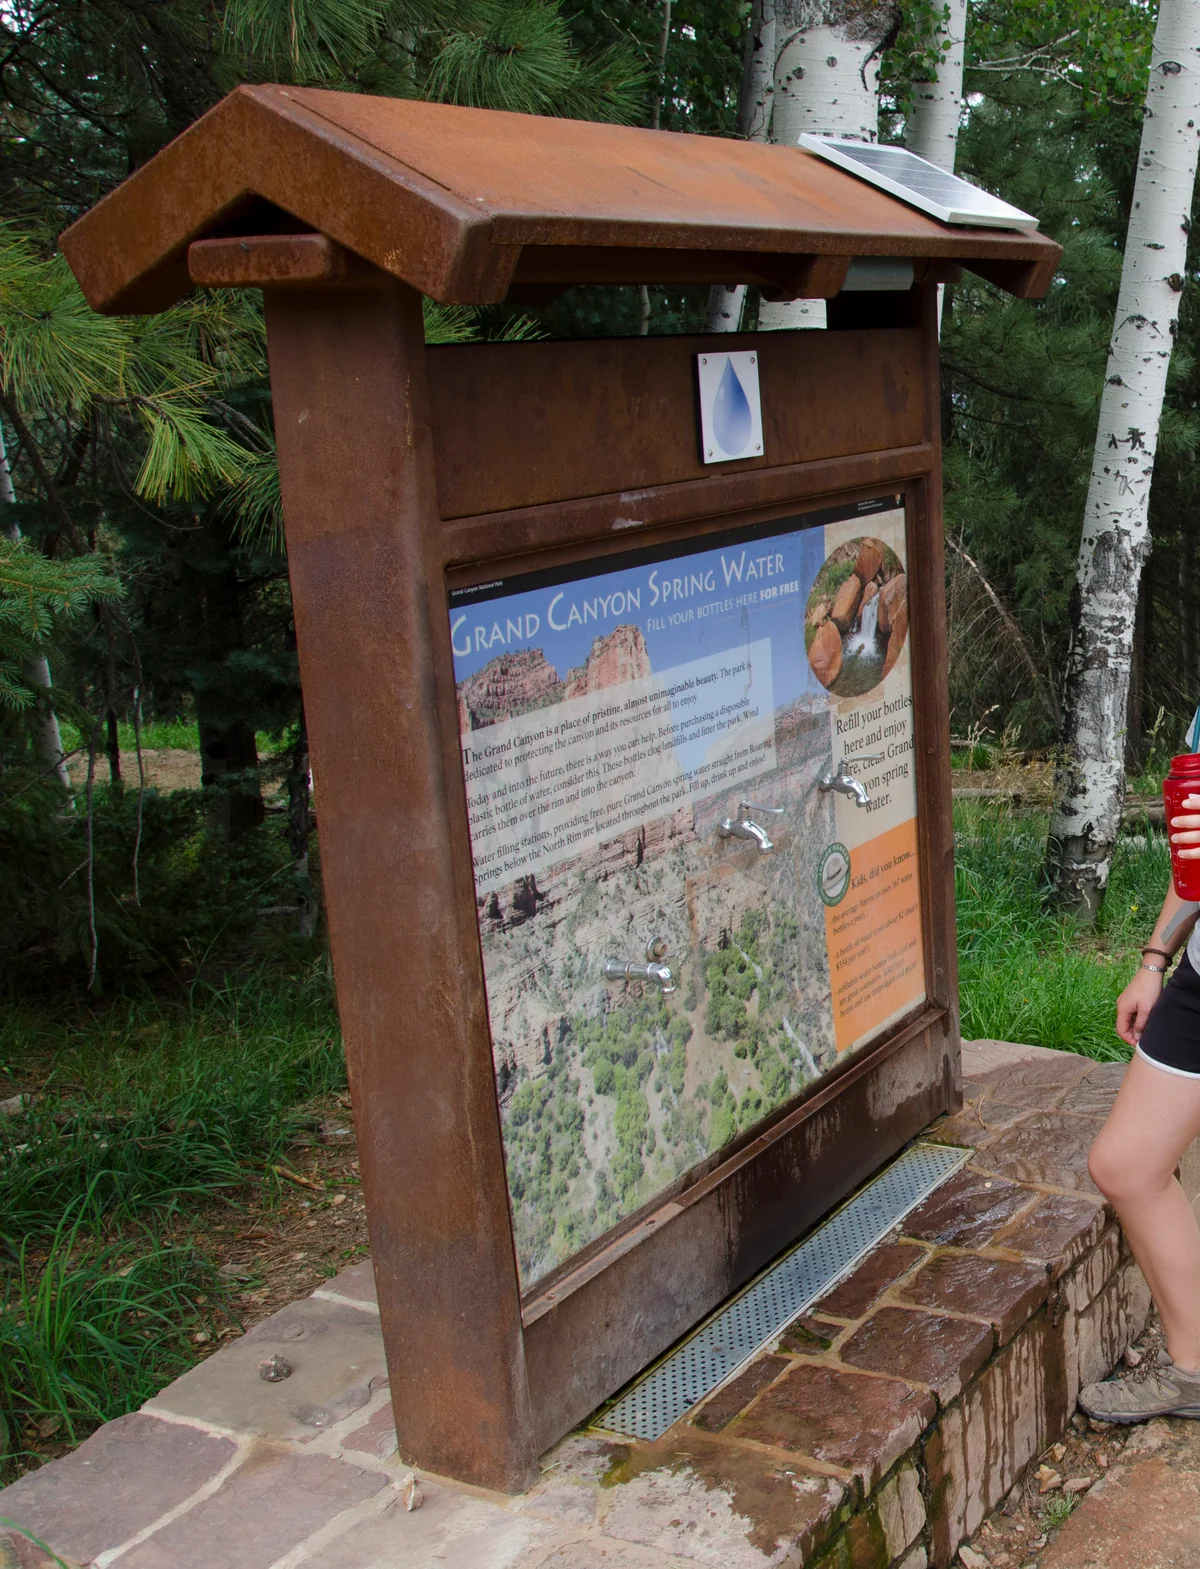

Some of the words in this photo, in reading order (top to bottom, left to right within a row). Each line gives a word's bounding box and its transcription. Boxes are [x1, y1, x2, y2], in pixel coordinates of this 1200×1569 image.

[450, 614, 540, 657] GRAND
[548, 588, 640, 631] CANYON
[649, 570, 715, 607] SPRING
[721, 551, 784, 587] WATER
[452, 589, 464, 597] Grand
[647, 617, 665, 633] FILL
[668, 610, 694, 626] YOUR
[698, 599, 733, 619] BOTTLES
[736, 592, 757, 608] HERE
[761, 587, 777, 601] FOR
[780, 581, 799, 596] FREE
[464, 748, 482, 765] The
[485, 739, 511, 758] Grand
[514, 731, 544, 748] Canyon
[546, 727, 552, 737] is
[553, 726, 559, 735] a
[561, 719, 580, 736] place
[583, 712, 590, 725] of
[592, 706, 622, 725] pristine,
[624, 696, 647, 711] almost
[649, 679, 694, 702] unimaginable
[696, 674, 718, 687] beauty.
[720, 668, 731, 679] The
[733, 662, 746, 678] park
[745, 660, 752, 669] is
[505, 759, 512, 768] to
[515, 744, 553, 768] protecting
[555, 739, 566, 751] the
[568, 730, 594, 746] canyon
[596, 723, 609, 736] and
[610, 722, 618, 731] its
[620, 710, 651, 728] resources
[653, 706, 662, 716] for
[663, 701, 671, 713] all
[673, 701, 679, 709] to
[680, 695, 698, 707] enjoy.
[836, 712, 859, 736] Refill
[862, 708, 882, 730] your
[884, 695, 912, 716] bottles
[844, 738, 863, 756] here
[866, 726, 882, 747] and
[884, 720, 907, 739] enjoy
[492, 784, 507, 800] and
[509, 781, 524, 794] into
[526, 775, 538, 787] the
[540, 767, 565, 782] future,
[566, 759, 584, 772] there
[586, 755, 592, 765] is
[593, 754, 597, 762] a
[598, 749, 611, 760] way
[614, 744, 626, 754] you
[628, 739, 639, 749] can
[641, 732, 657, 744] help.
[658, 724, 679, 738] Before
[681, 712, 714, 733] purchasing
[720, 698, 750, 716] disposable
[495, 799, 517, 816] bottle
[520, 793, 527, 806] of
[529, 788, 552, 802] water,
[554, 774, 584, 793] consider
[603, 760, 622, 774] These
[624, 751, 646, 766] bottles
[648, 746, 661, 757] clog
[662, 735, 687, 751] landfills
[689, 729, 700, 742] and
[701, 725, 715, 737] litter
[717, 721, 726, 731] the
[727, 715, 742, 730] park.
[743, 707, 759, 720] Wind
[882, 763, 908, 787] spring
[887, 735, 913, 759] Grand
[472, 852, 495, 867] Water
[497, 842, 519, 859] filling
[521, 830, 552, 847] stations,
[554, 814, 588, 838] providing
[590, 808, 605, 820] free,
[607, 800, 622, 816] pure
[624, 788, 645, 805] Grand
[647, 780, 671, 796] Canyon
[673, 771, 692, 787] spring
[694, 764, 710, 776] water
[712, 755, 733, 770] straight
[734, 749, 748, 761] from
[750, 740, 771, 754] Roaring
[498, 817, 517, 831] them
[520, 809, 535, 822] over
[538, 804, 550, 815] the
[551, 798, 564, 810] rim
[566, 789, 579, 804] and
[581, 786, 595, 798] into
[597, 781, 607, 792] the
[609, 771, 635, 787] canyon.
[504, 855, 528, 872] below
[529, 850, 541, 861] the
[543, 838, 565, 856] North
[567, 833, 581, 845] Rim
[583, 827, 594, 838] are
[596, 813, 621, 833] located
[622, 799, 659, 821] throughout
[660, 795, 670, 805] the
[672, 787, 688, 804] park.
[689, 780, 699, 793] Fill
[701, 779, 710, 790] up,
[711, 770, 727, 784] drink
[729, 768, 736, 778] up
[737, 761, 748, 773] and
[749, 753, 765, 768] enjoy!
[852, 874, 868, 890] Kids,
[870, 865, 879, 880] did
[881, 861, 892, 877] you
[893, 851, 915, 867] know...
